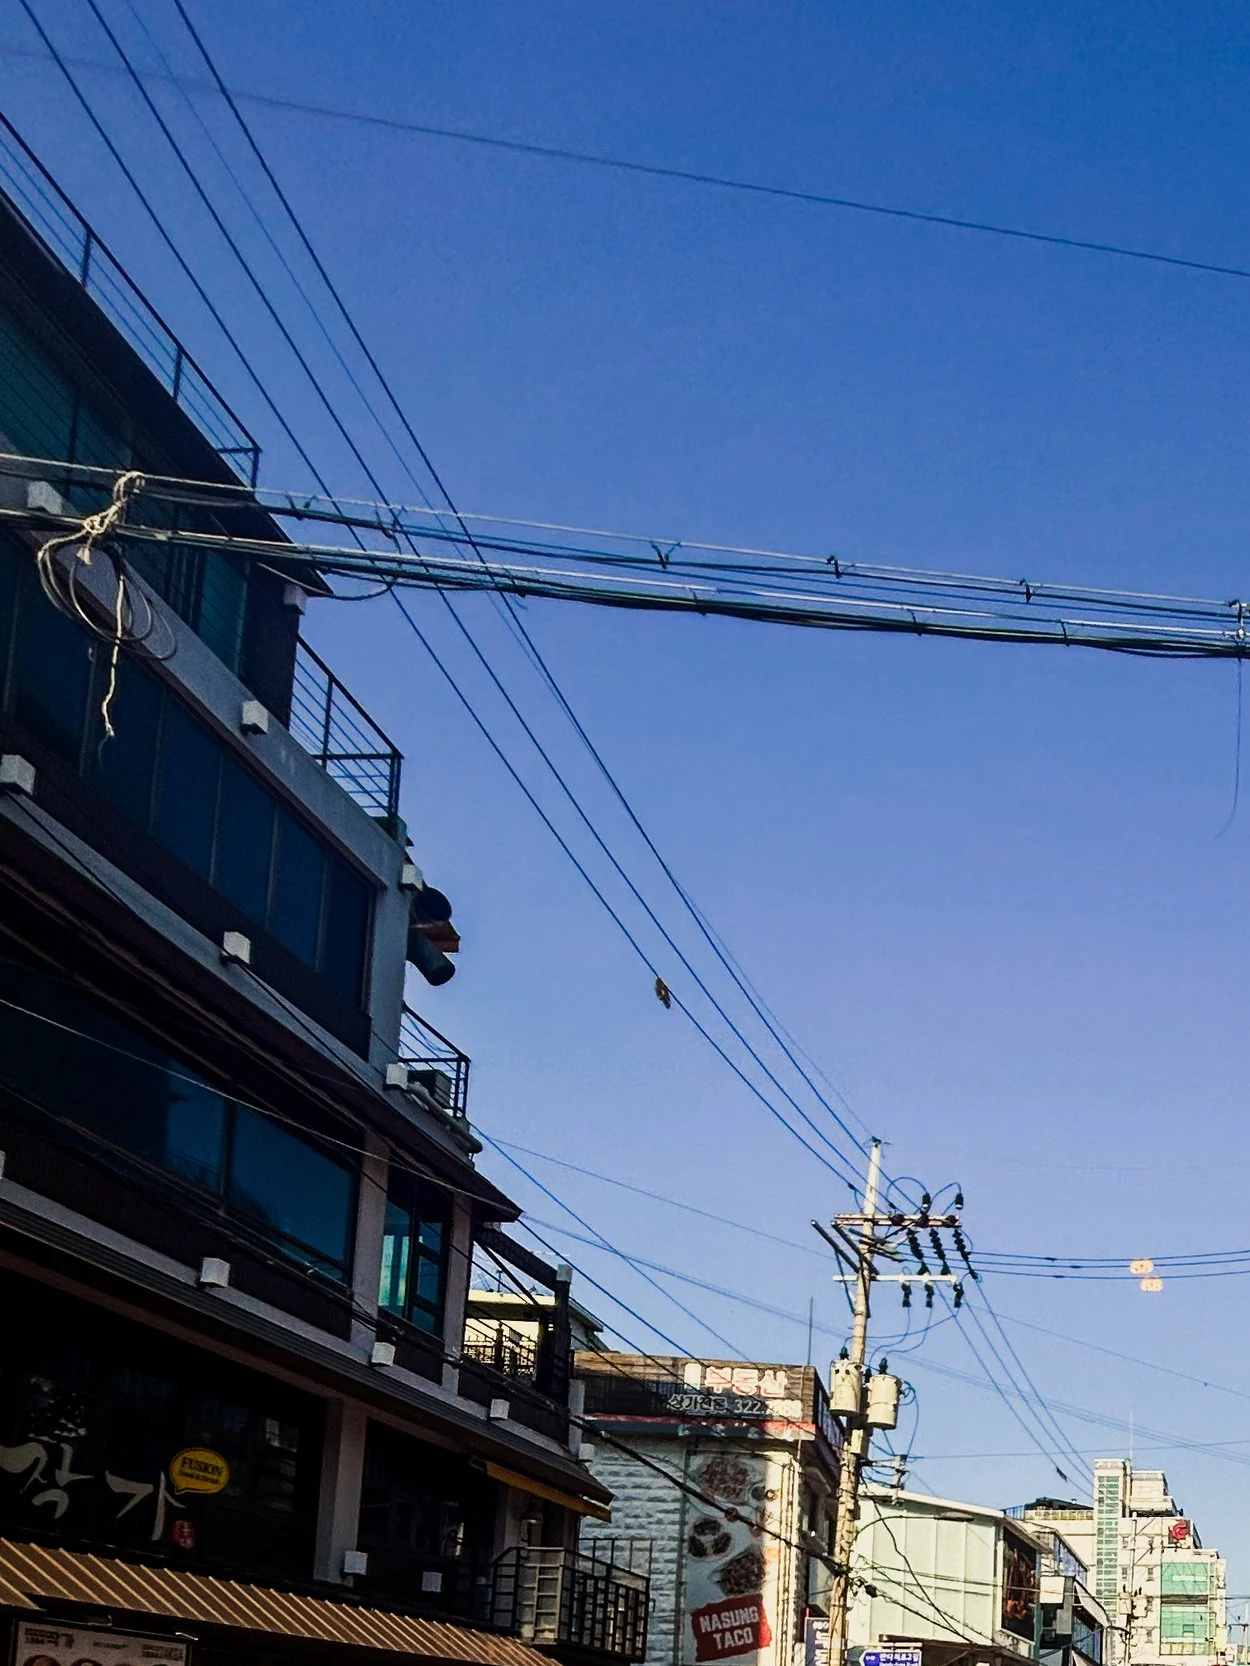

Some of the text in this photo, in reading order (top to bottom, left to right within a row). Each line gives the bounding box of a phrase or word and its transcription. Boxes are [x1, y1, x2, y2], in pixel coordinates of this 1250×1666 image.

[704, 1366, 788, 1398] 부동산
[181, 1457, 223, 1477] FUSION
[699, 1605, 760, 1633] NASUNG
[712, 1627, 754, 1650] TACO
